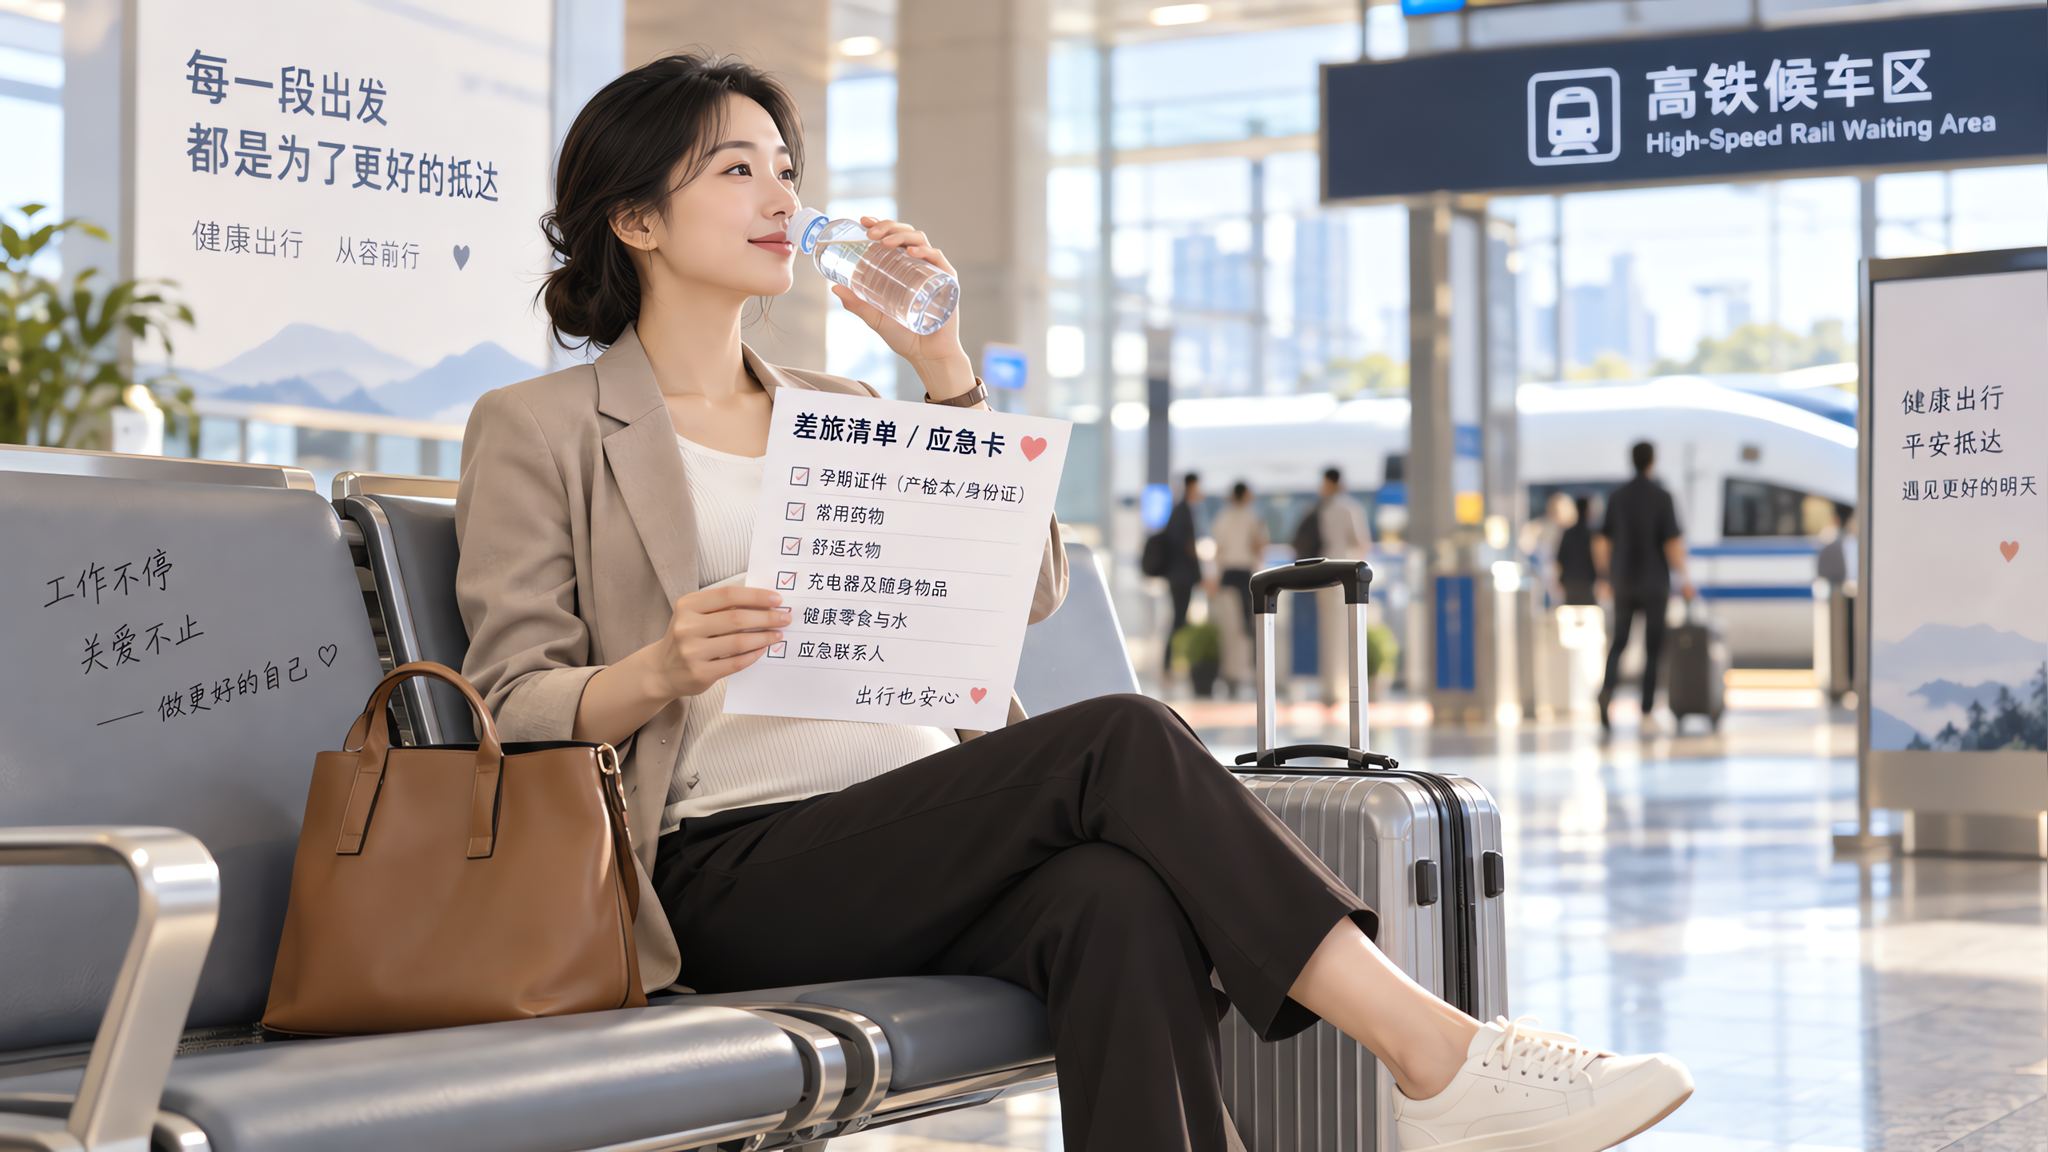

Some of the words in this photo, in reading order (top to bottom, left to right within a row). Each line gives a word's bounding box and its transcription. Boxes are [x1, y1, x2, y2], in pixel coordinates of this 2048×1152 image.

[186, 49, 387, 126] 每一段出发
[1645, 49, 1932, 122] 高铁候车区
[1646, 124, 1782, 158] High-Speed
[1790, 121, 1835, 144] Rail
[1842, 116, 1933, 142] Waiting
[1939, 113, 1996, 135] Area
[186, 122, 498, 202] 都是为了更好的抵达
[192, 220, 303, 259] 健康出行
[335, 236, 420, 270] 从容前行
[1901, 385, 2004, 415] 健康出行
[793, 412, 897, 447] 差旅清单
[926, 426, 1005, 458] 应急卡
[1901, 428, 2004, 459] 平安抵达
[1901, 476, 2037, 501] 遇见更好的明天
[816, 503, 885, 525] 常用药物
[812, 538, 881, 559] 舒适衣物
[44, 549, 172, 607] 工作不停
[807, 573, 948, 597] 充电器及随身物品
[803, 607, 908, 629] 健康零食与水
[81, 614, 204, 674] 关爱不止
[798, 641, 885, 662] 应急联系人
[157, 657, 308, 722] 做更好的自己
[855, 685, 959, 707] 出行也安心
